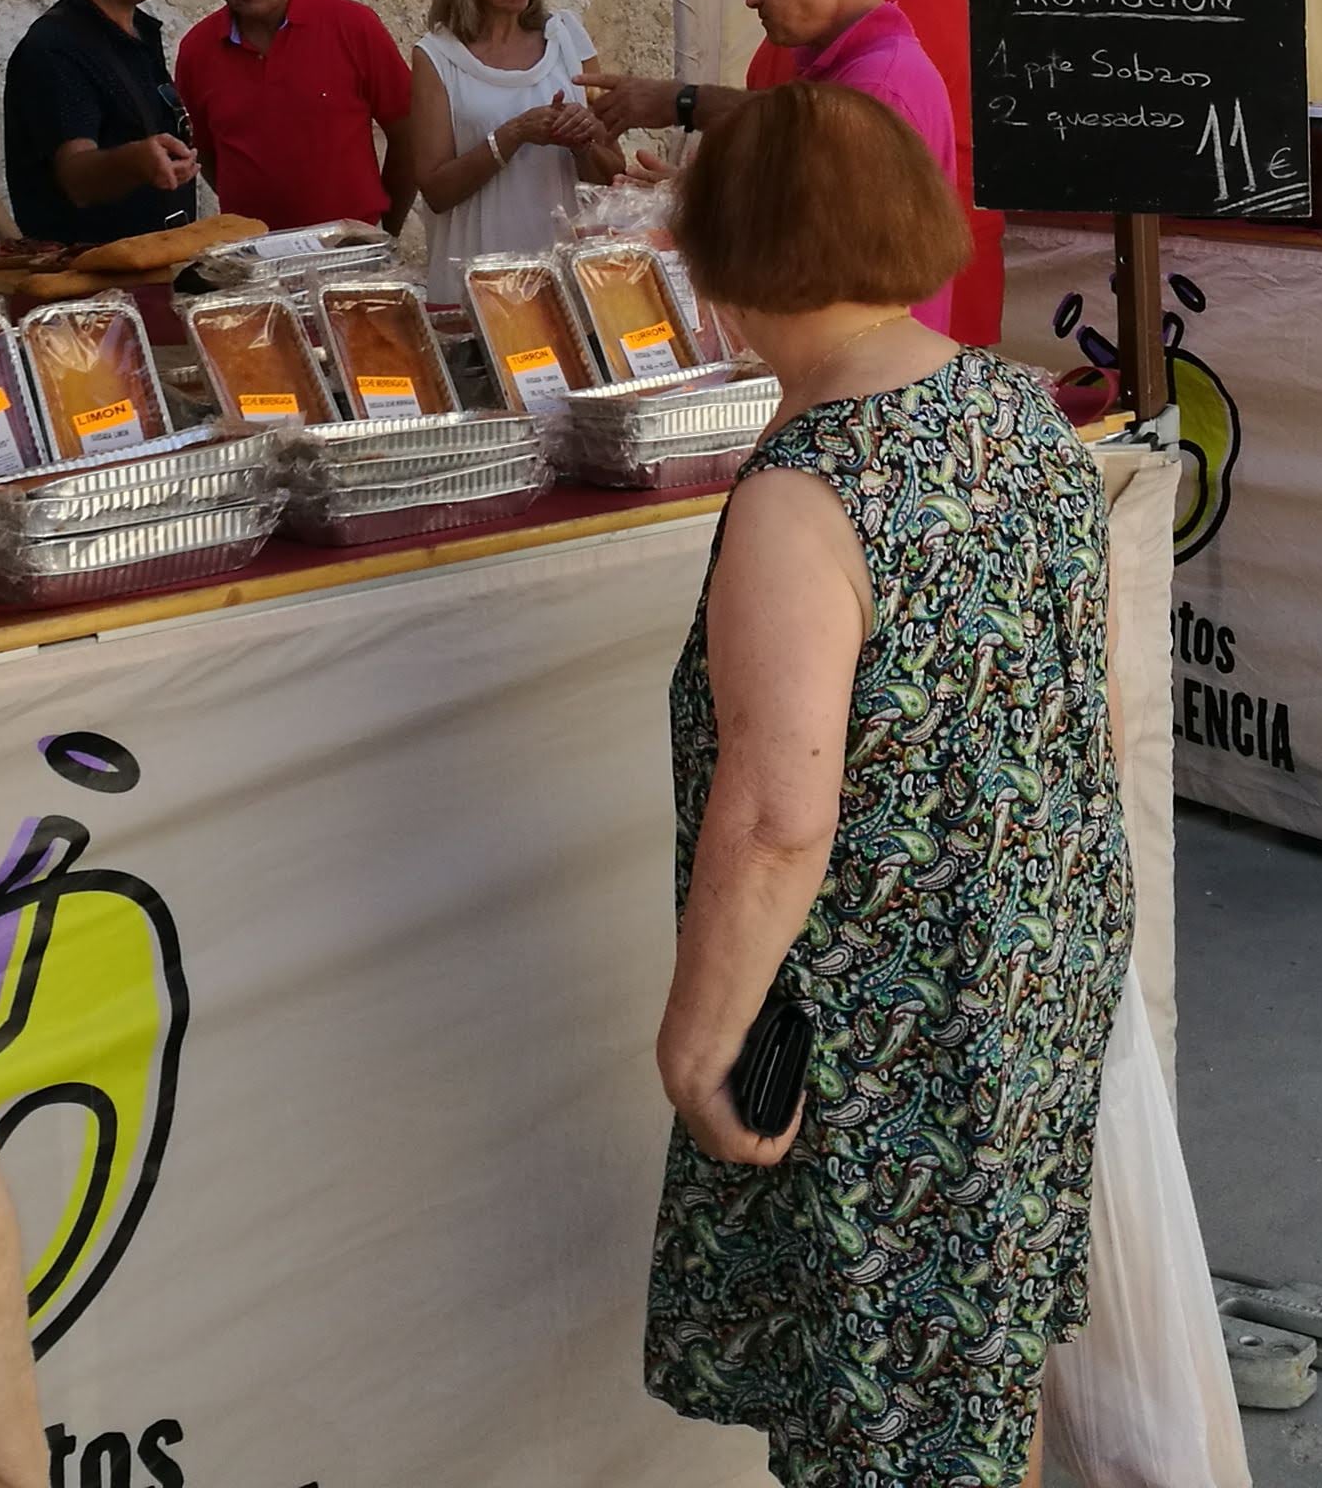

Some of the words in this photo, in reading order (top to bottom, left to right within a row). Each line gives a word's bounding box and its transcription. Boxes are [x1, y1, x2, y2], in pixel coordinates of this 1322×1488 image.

[1091, 48, 1212, 88] Sobaos
[988, 94, 1031, 127] 2
[1047, 104, 1186, 142] quesadas
[1195, 97, 1258, 203] 11
[1267, 146, 1299, 180] €
[628, 326, 667, 342] TURRON
[511, 351, 550, 366] TURRON
[76, 404, 127, 427] LIMON
[1170, 600, 1236, 674] tos
[44, 1418, 184, 1488] tos
